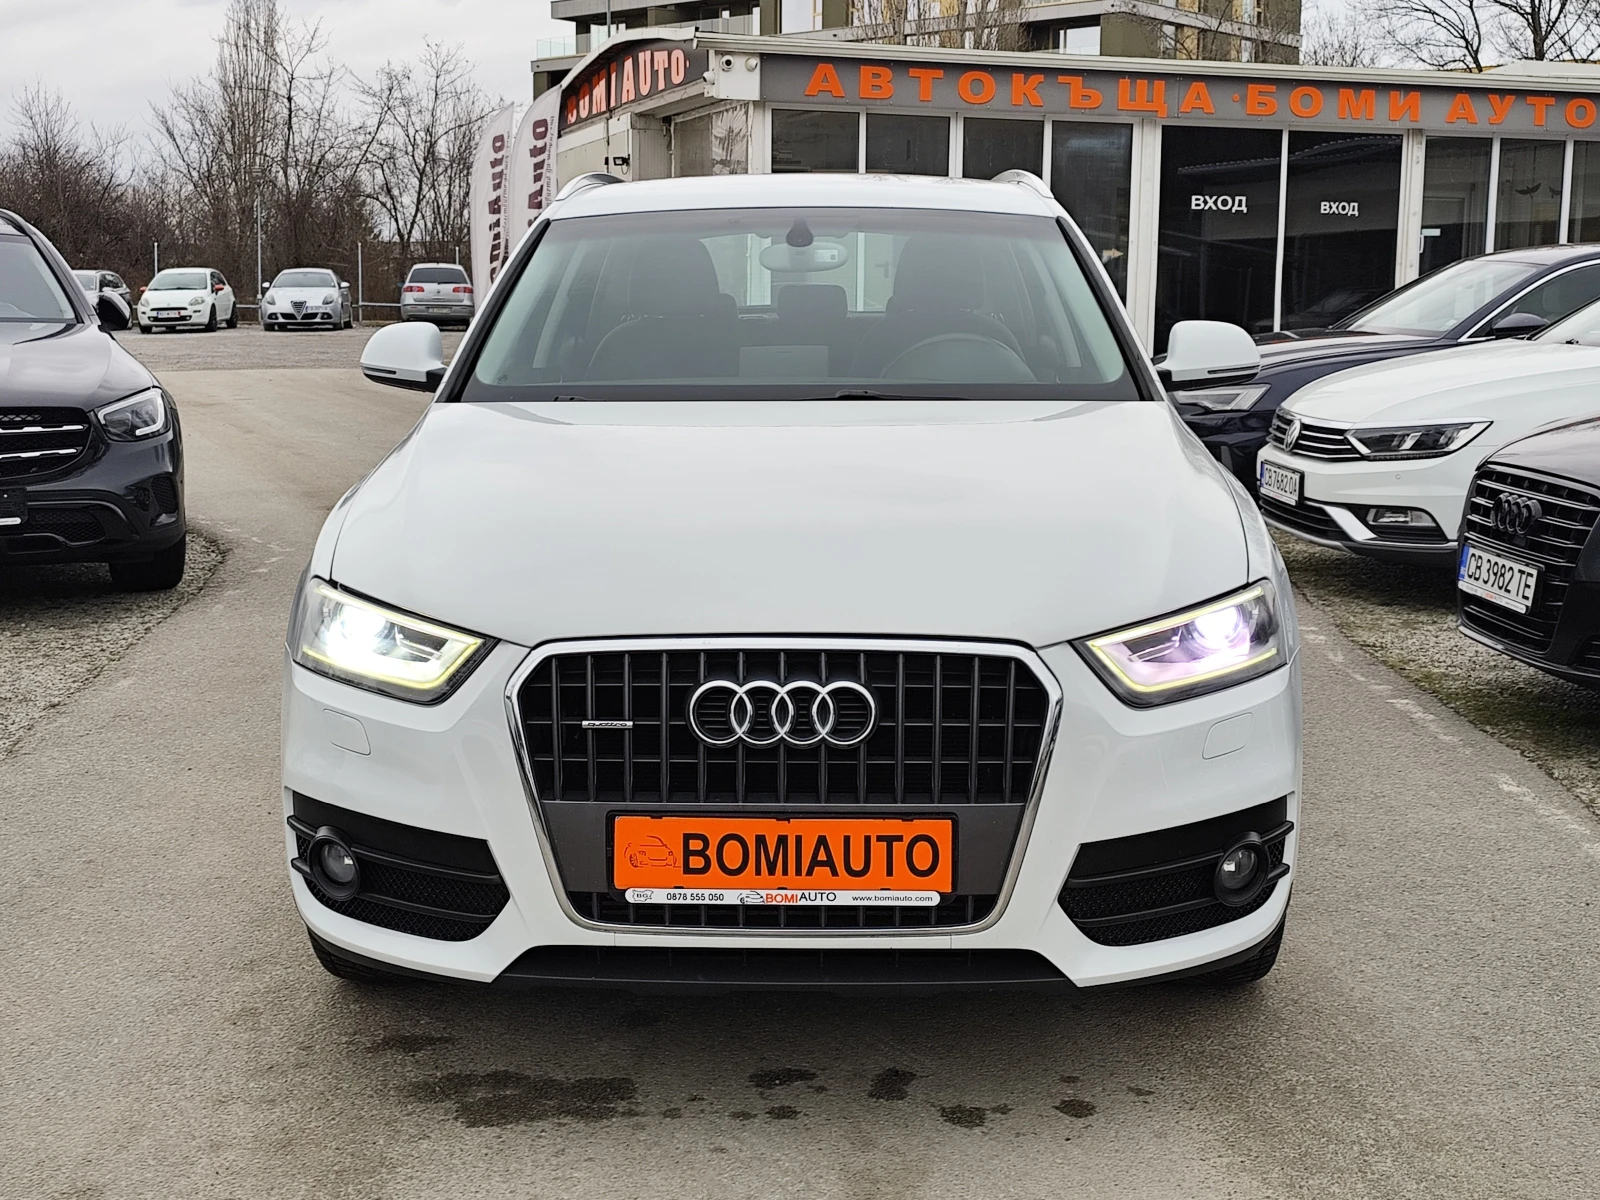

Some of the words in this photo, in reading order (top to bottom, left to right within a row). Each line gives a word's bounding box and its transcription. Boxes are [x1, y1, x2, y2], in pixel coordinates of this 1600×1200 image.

[565, 48, 686, 126] BOMIAUTO
[804, 62, 1215, 118] АВТОКЪЩА
[1245, 83, 1422, 123] БОМИ
[1444, 93, 1598, 129] АУТО
[1190, 194, 1248, 213] ВХОД
[1319, 200, 1359, 217] ВХОД
[1467, 552, 1483, 581] CB
[1482, 558, 1515, 594] 3982
[1516, 568, 1534, 601] TE
[681, 832, 941, 879] BOMIAUTO
[666, 892, 688, 901] 0878
[690, 893, 706, 901] 555
[708, 893, 724, 902] 050
[852, 894, 933, 903] www.bomiauto.com
